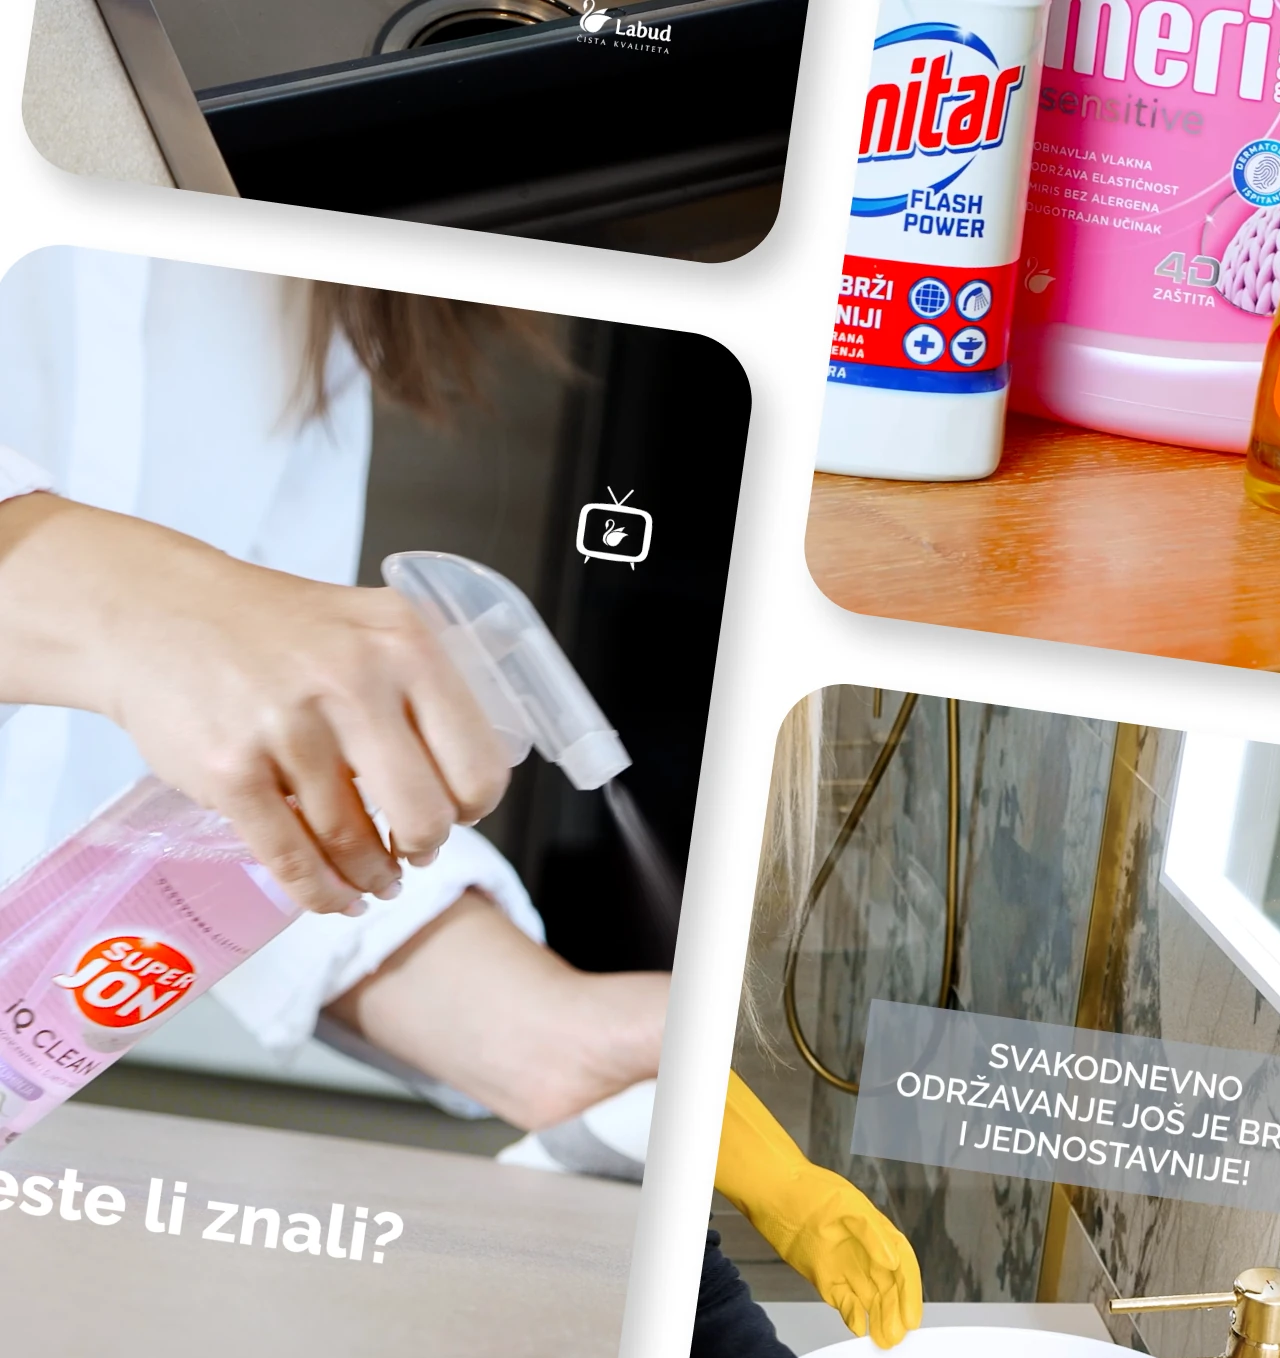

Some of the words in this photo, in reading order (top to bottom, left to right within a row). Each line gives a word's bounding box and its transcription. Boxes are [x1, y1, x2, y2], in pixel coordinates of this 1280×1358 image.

[1040, 87, 1205, 135] sensitive
[1033, 141, 1097, 162] OBNAVLJA
[1101, 152, 1152, 170] VLAKNA
[1031, 161, 1088, 181] ODRŽAVA
[1092, 172, 1179, 196] ELASTIČNOST
[911, 189, 983, 215] FLASH
[1028, 182, 1060, 196] MIRIS
[1064, 188, 1088, 202] BEZ
[1091, 193, 1160, 213] ALERGENA
[903, 213, 985, 238] POWER
[1026, 201, 1109, 226] DUGOTRAJAN
[1113, 216, 1162, 235] UČINAK
[1154, 251, 1221, 288] 4D
[839, 273, 894, 301] BRŽI
[1153, 287, 1216, 308] ZAŠTITA
[102, 941, 197, 989] SUPER
[52, 958, 181, 1021] JON
[32, 1029, 100, 1076] CLEAN
